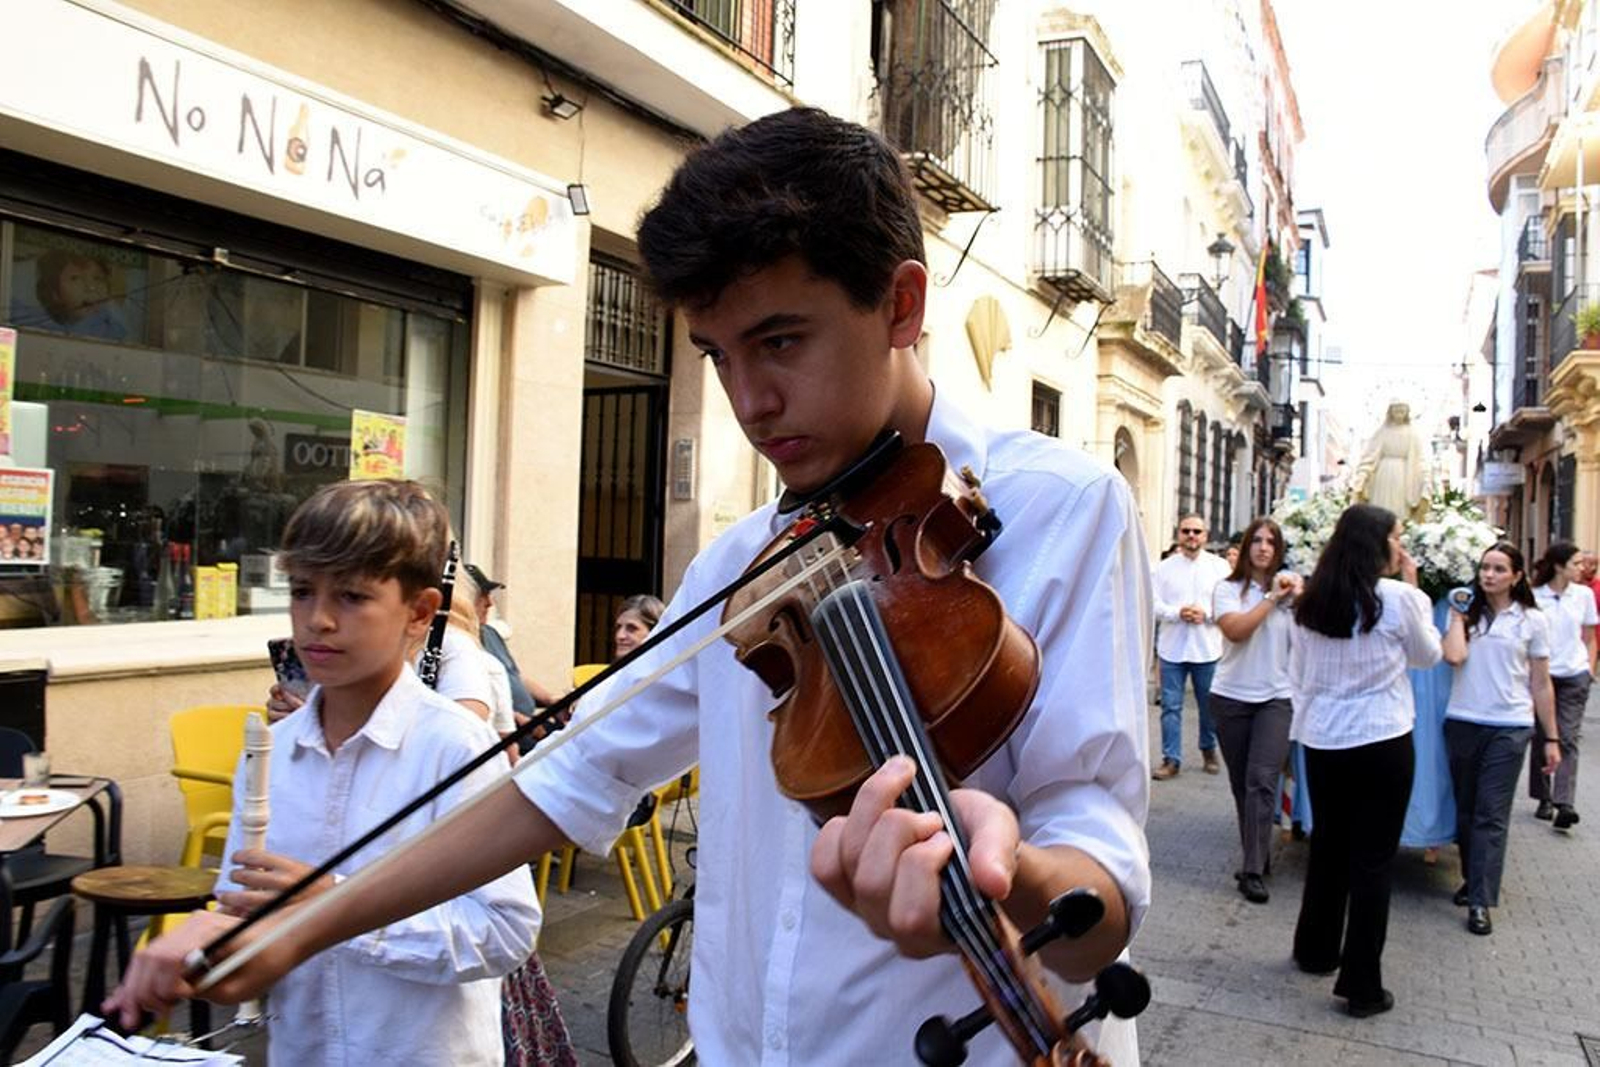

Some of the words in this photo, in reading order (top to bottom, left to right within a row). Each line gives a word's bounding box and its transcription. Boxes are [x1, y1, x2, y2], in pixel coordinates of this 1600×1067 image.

[134, 56, 206, 147] No
[237, 92, 308, 176] No
[326, 125, 387, 201] Na
